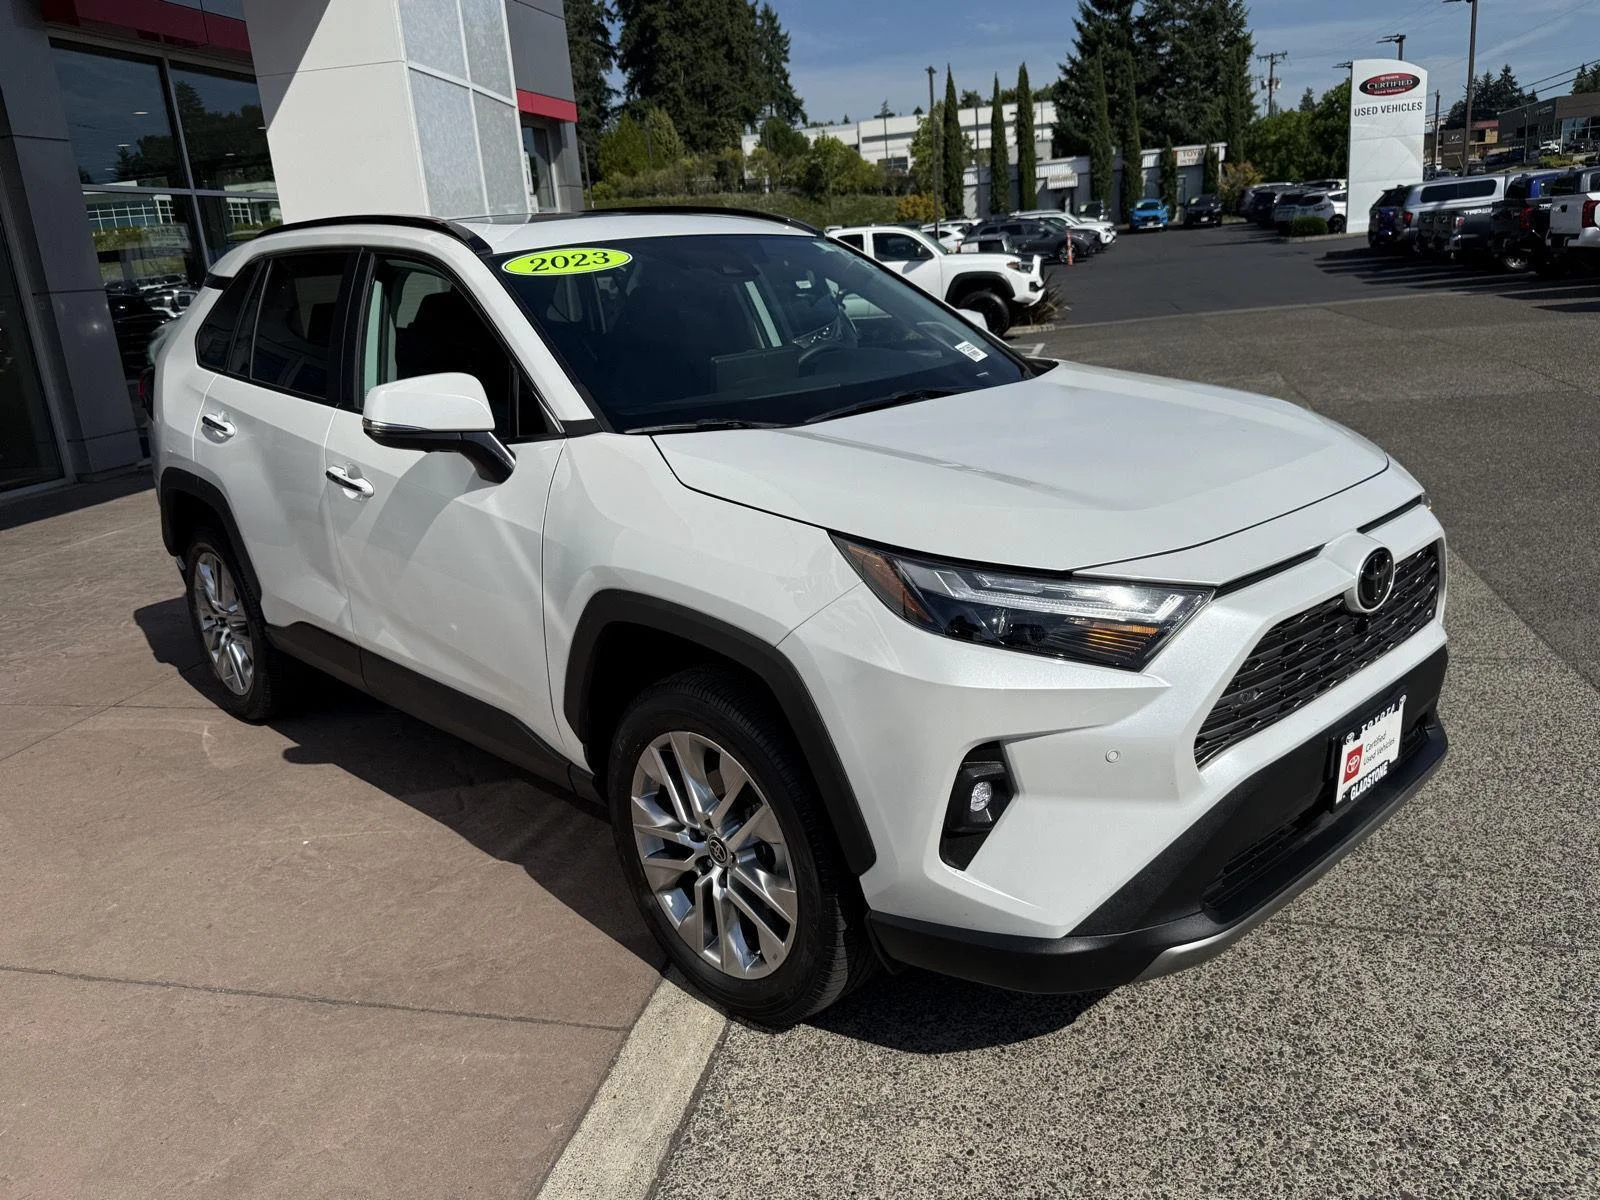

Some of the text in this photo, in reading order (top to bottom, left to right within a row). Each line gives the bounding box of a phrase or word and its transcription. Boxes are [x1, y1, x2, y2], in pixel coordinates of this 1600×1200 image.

[1367, 79, 1413, 89] CERTIFIED
[1354, 101, 1423, 117] USED VEHICLES
[529, 251, 610, 272] 2023
[1362, 704, 1395, 731] TOYOTA
[1366, 730, 1386, 753] Certified
[1350, 762, 1387, 800] GLADSTONE
